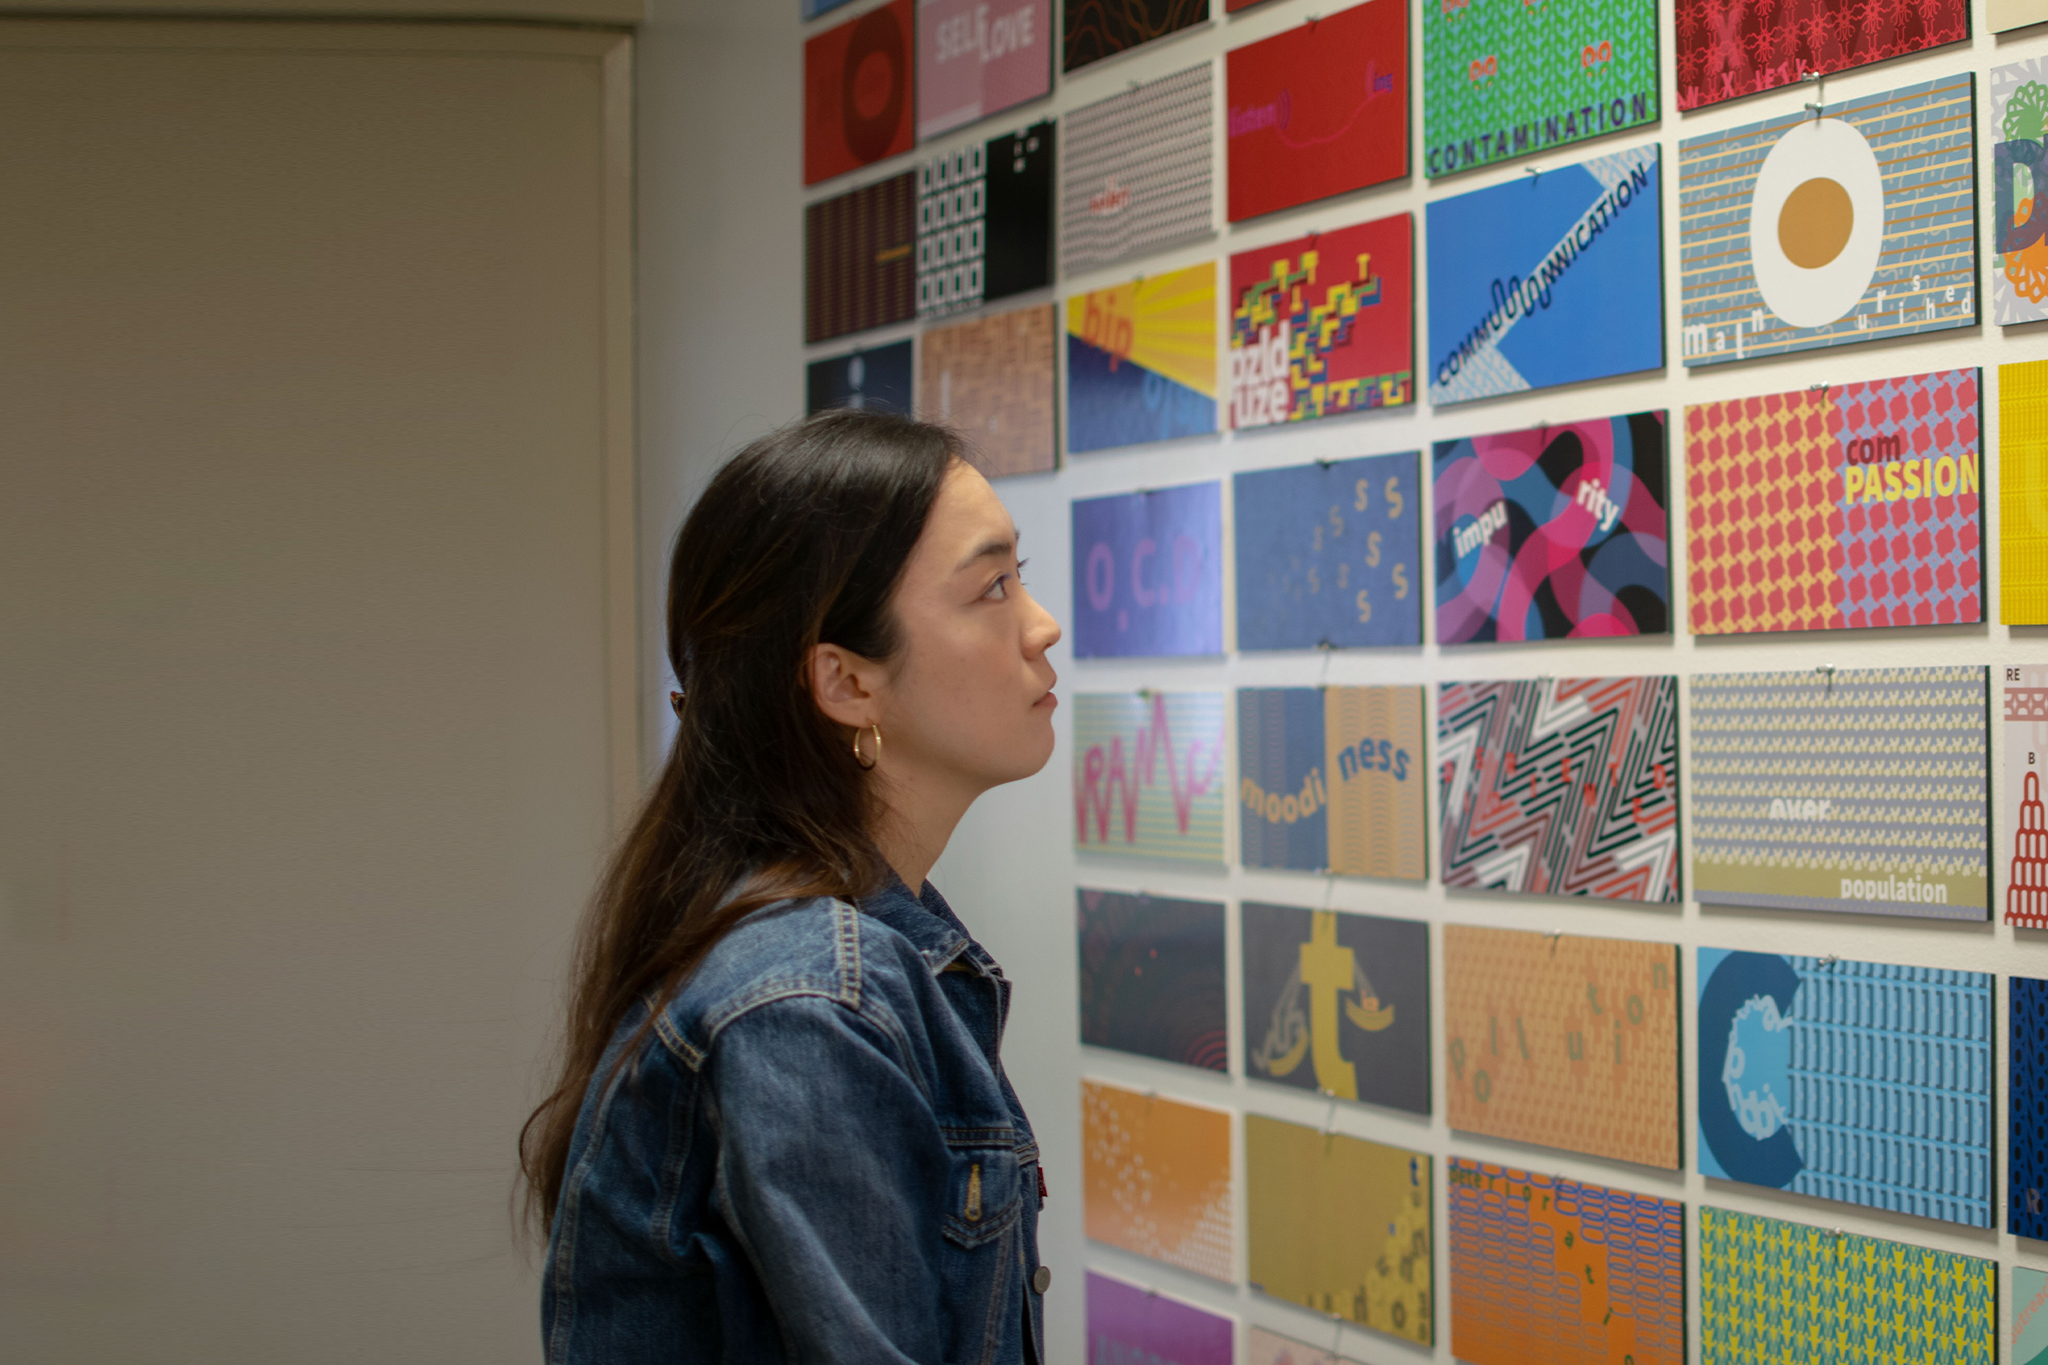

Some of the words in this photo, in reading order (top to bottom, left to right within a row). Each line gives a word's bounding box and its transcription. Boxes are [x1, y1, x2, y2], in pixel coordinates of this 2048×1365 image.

[1428, 92, 1647, 175] CONTAMINATION
[1846, 435, 1901, 466] com
[1576, 478, 1620, 532] rity
[1845, 453, 1979, 505] PASSION
[1453, 501, 1508, 558] impu
[2006, 668, 2021, 682] RE
[1338, 737, 1410, 782] ness
[1240, 766, 1327, 824] moodi
[1841, 874, 1949, 905] population
